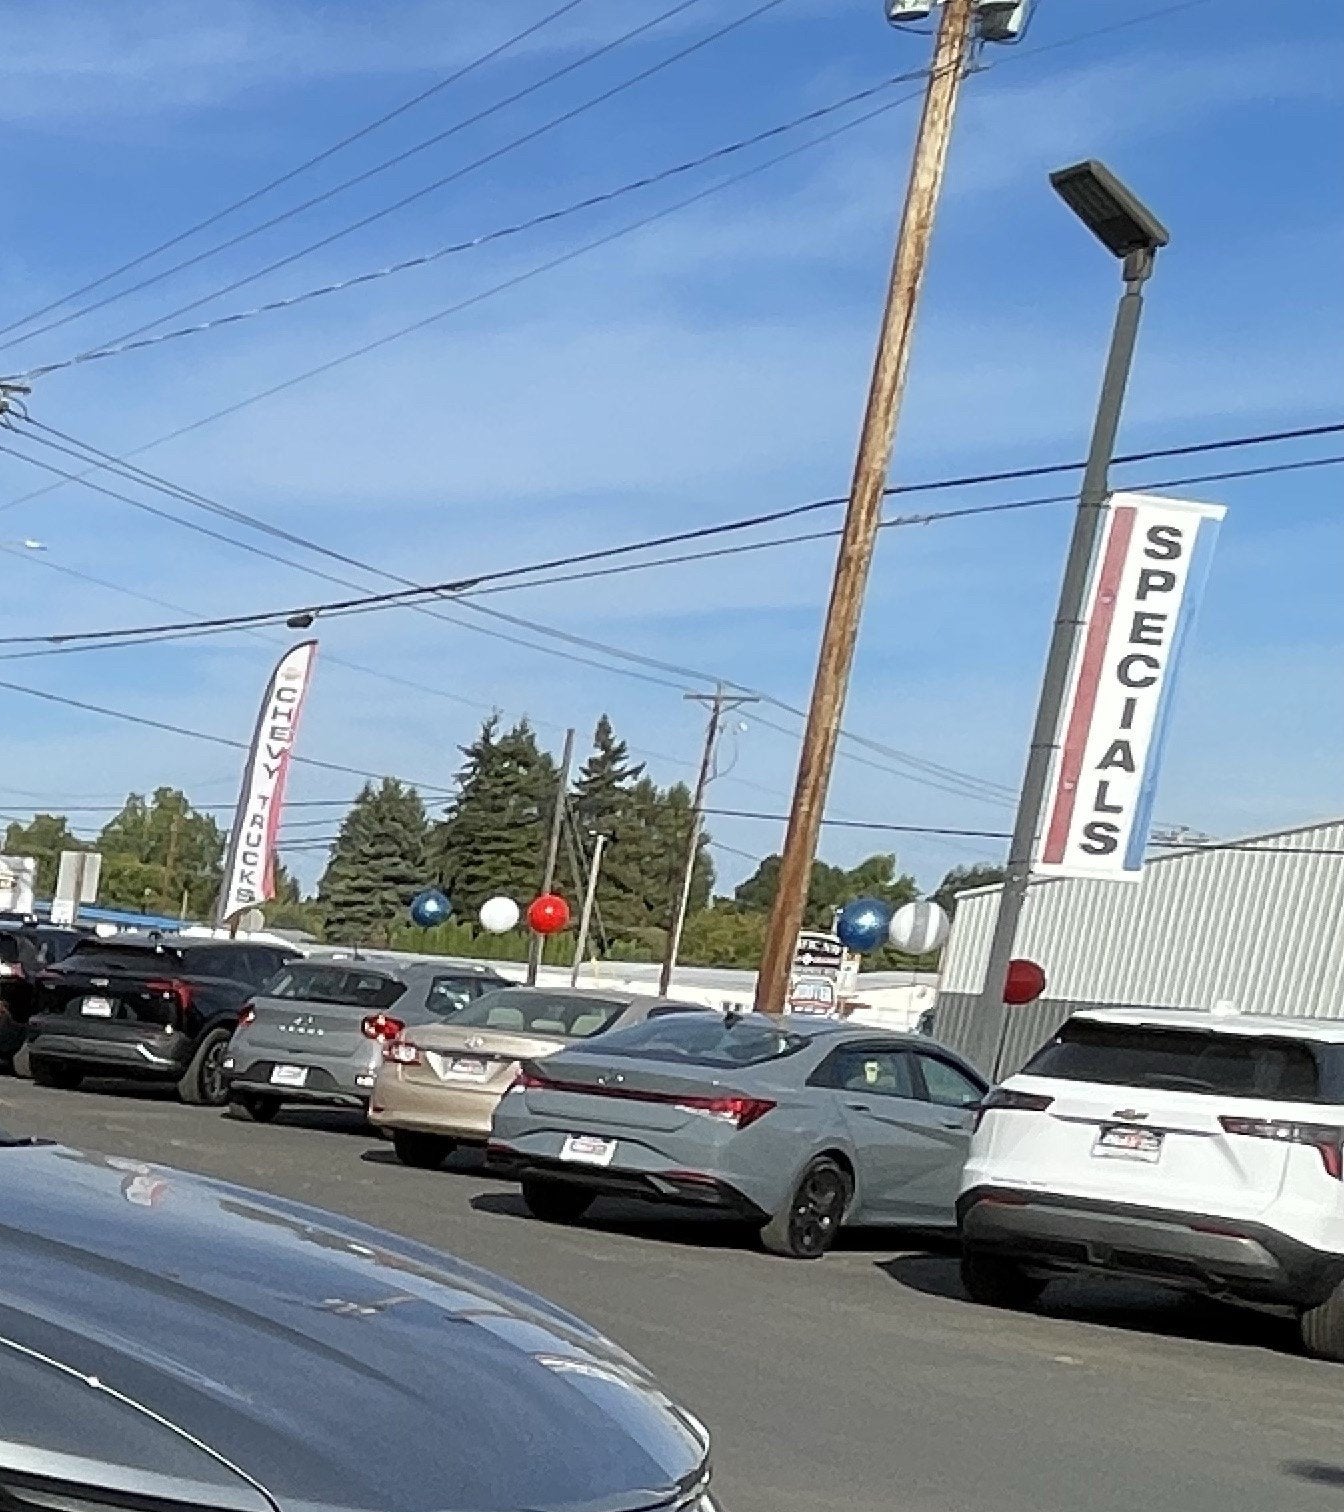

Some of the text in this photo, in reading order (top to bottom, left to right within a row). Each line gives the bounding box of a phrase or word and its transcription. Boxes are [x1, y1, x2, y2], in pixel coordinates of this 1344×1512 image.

[236, 687, 297, 903] CHEVY TRUCKS
[1080, 525, 1183, 855] SPECIALS
